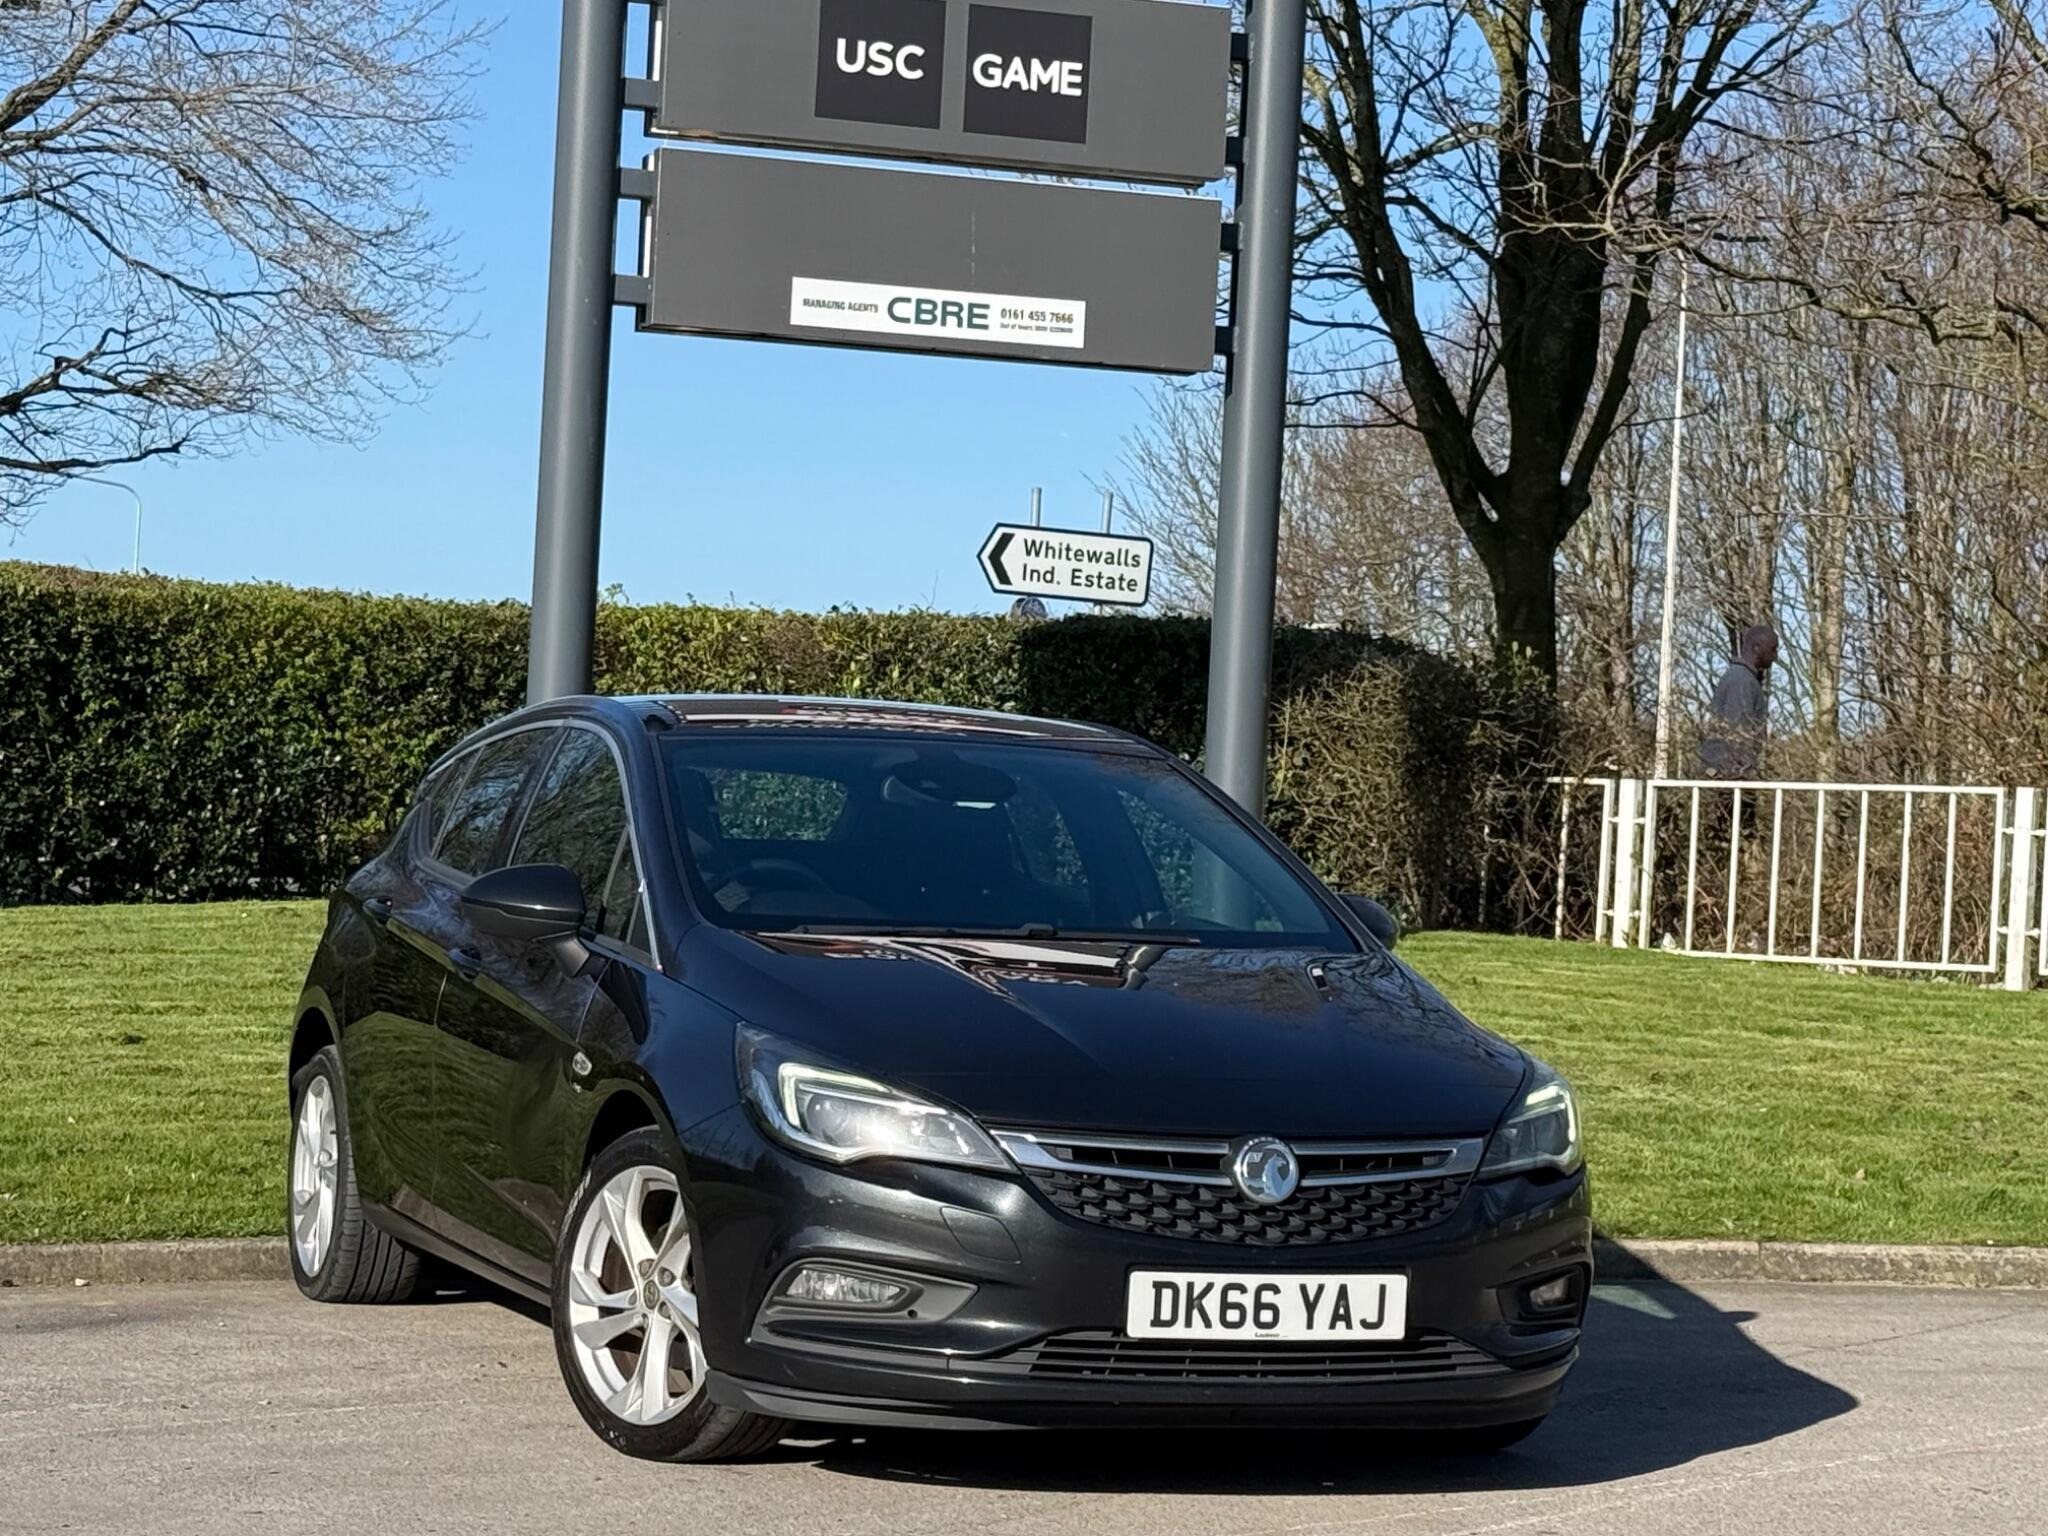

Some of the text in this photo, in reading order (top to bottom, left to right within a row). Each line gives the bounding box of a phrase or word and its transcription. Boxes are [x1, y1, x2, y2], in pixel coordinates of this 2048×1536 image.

[836, 37, 925, 80] USC
[972, 53, 1083, 96] GAME
[887, 296, 991, 331] CBRE
[1000, 308, 1025, 321] 0161
[1027, 310, 1047, 322] 455
[1023, 538, 1141, 568] Whitewalls
[1022, 563, 1138, 592] Ind. Estate
[1150, 1280, 1387, 1331] DK66 YAJ
